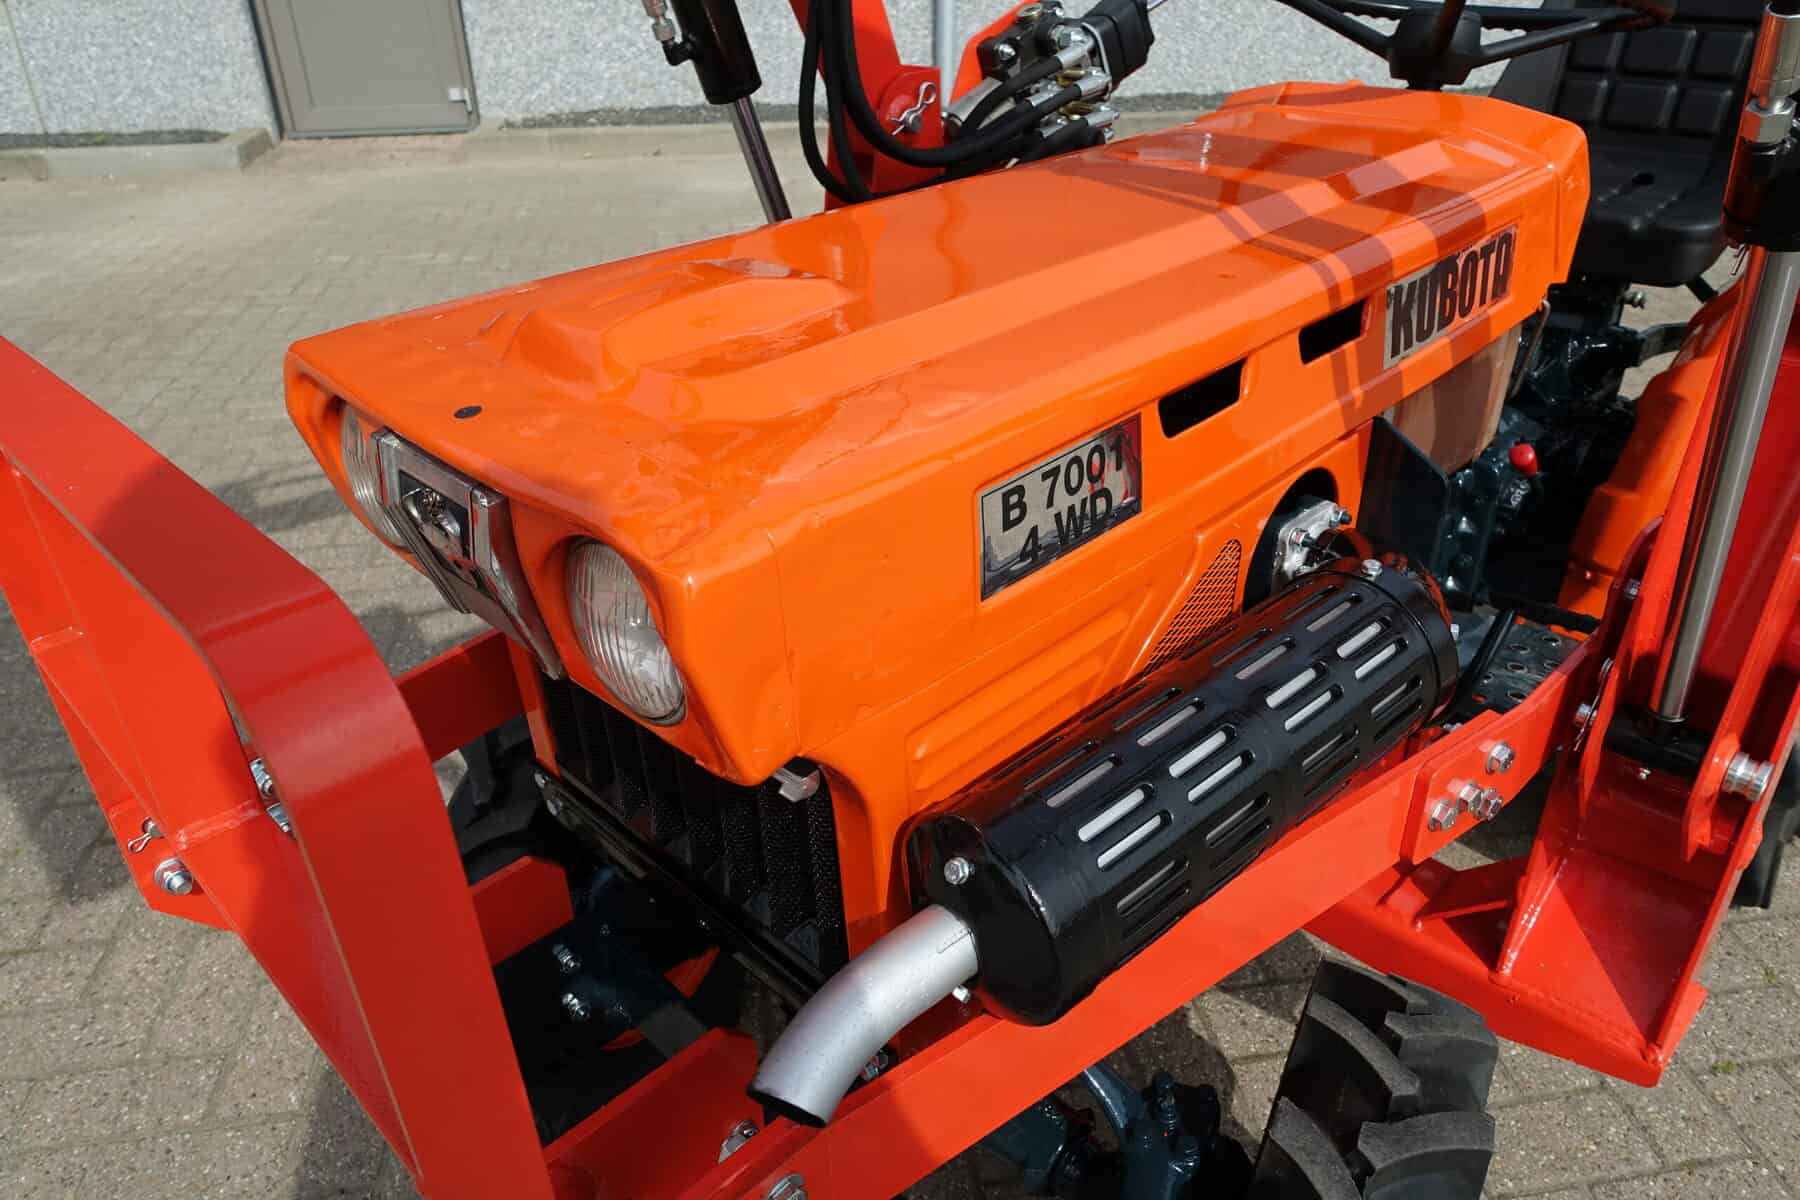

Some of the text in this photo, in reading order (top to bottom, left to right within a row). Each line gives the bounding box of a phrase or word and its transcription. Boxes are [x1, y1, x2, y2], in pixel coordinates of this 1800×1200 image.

[1390, 232, 1513, 358] KUBOTA
[1001, 433, 1123, 532] B 7001
[1020, 487, 1114, 562] 4 WD
